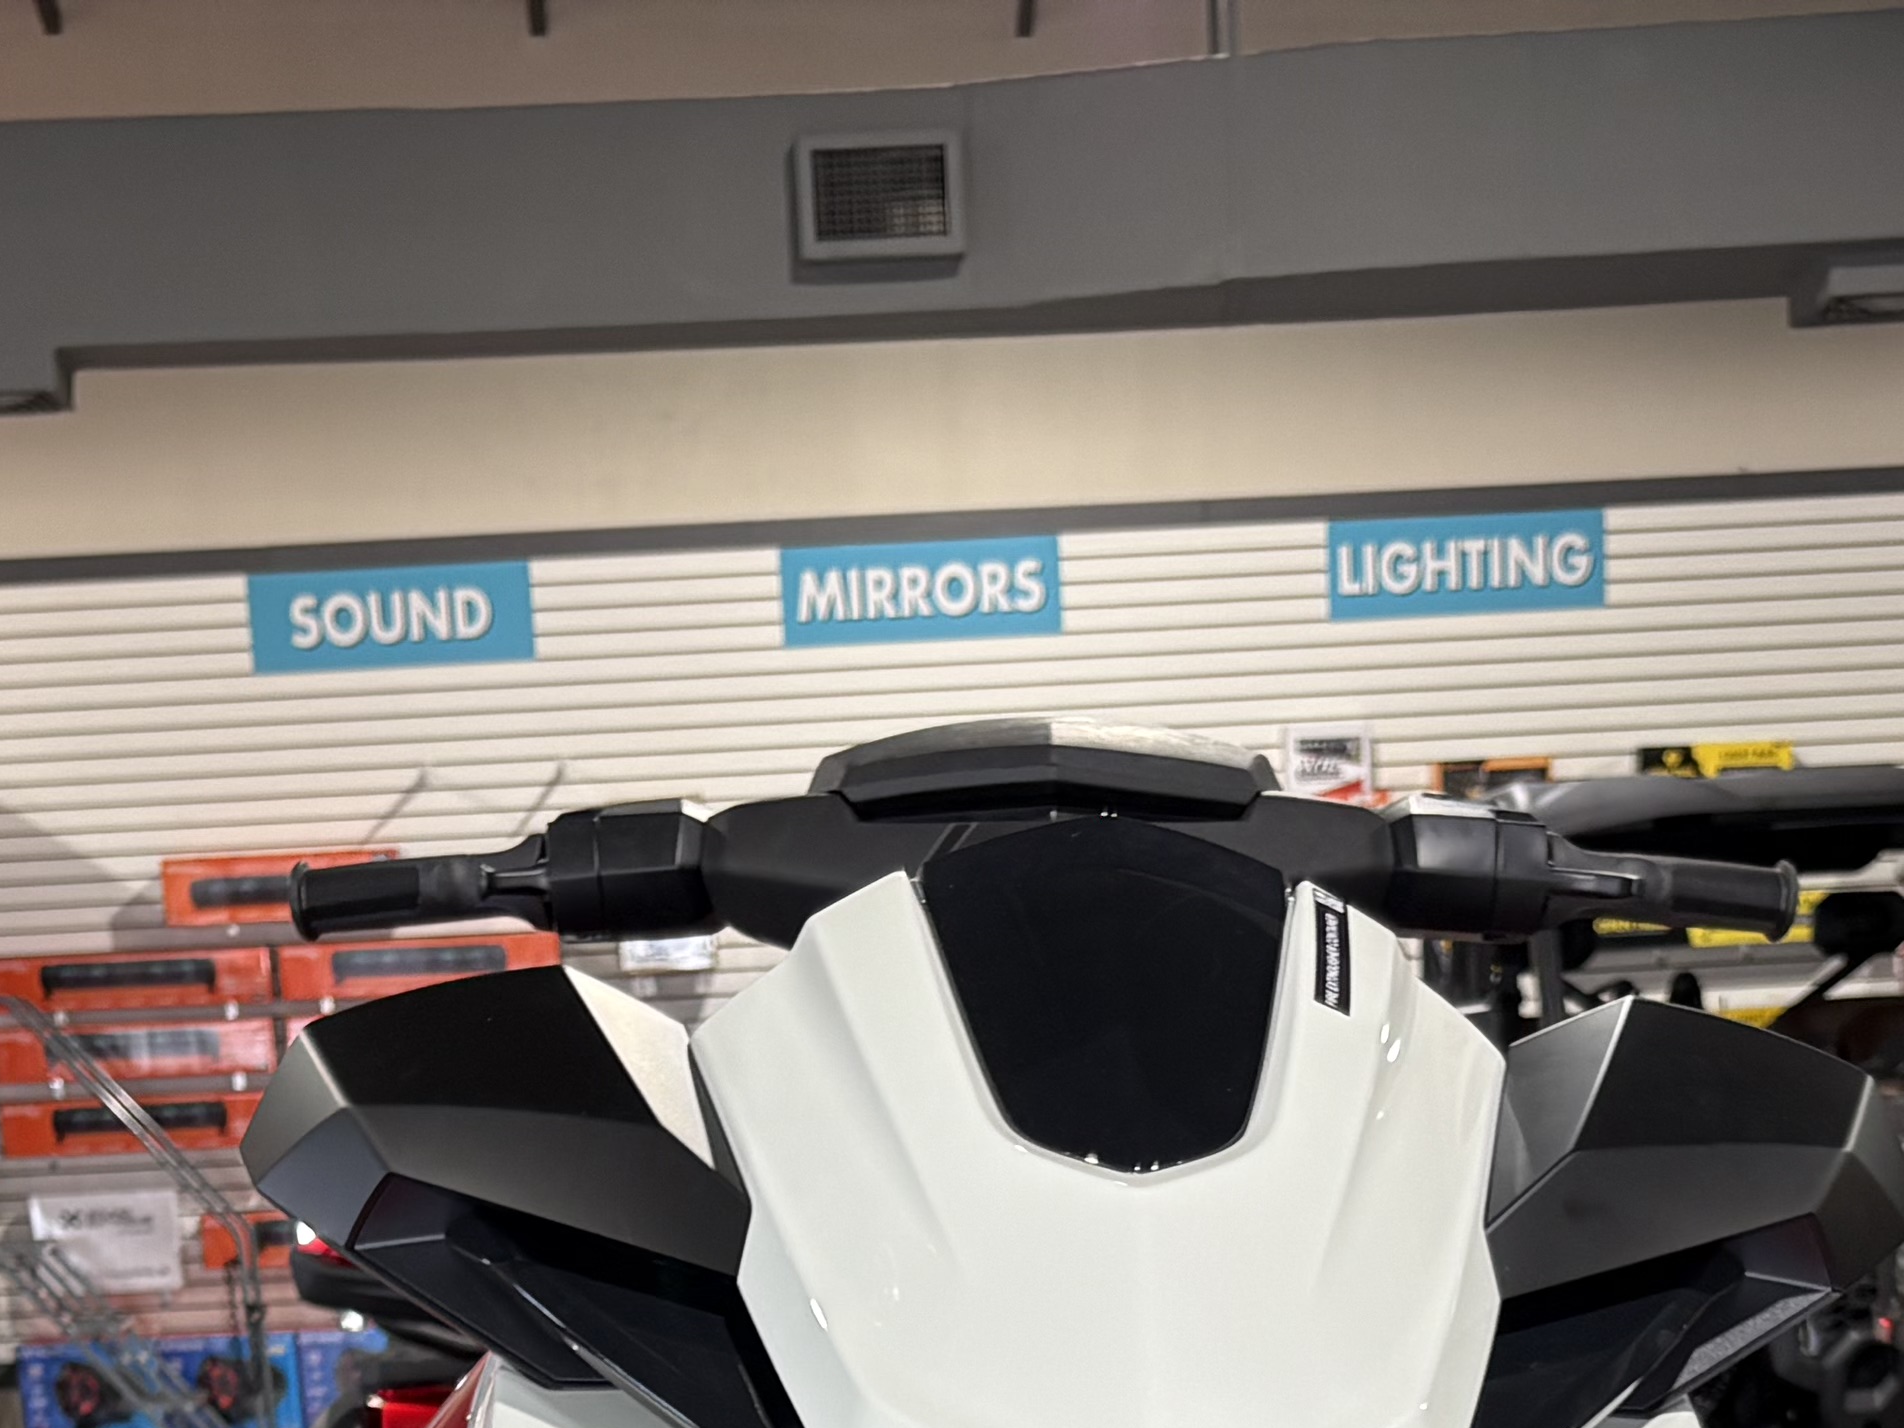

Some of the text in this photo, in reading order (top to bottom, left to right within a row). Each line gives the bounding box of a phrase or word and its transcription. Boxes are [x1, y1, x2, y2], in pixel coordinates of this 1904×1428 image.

[796, 559, 1046, 623] MIRRORS
[1337, 532, 1593, 597] LIGHTING
[289, 586, 493, 650] SOUND
